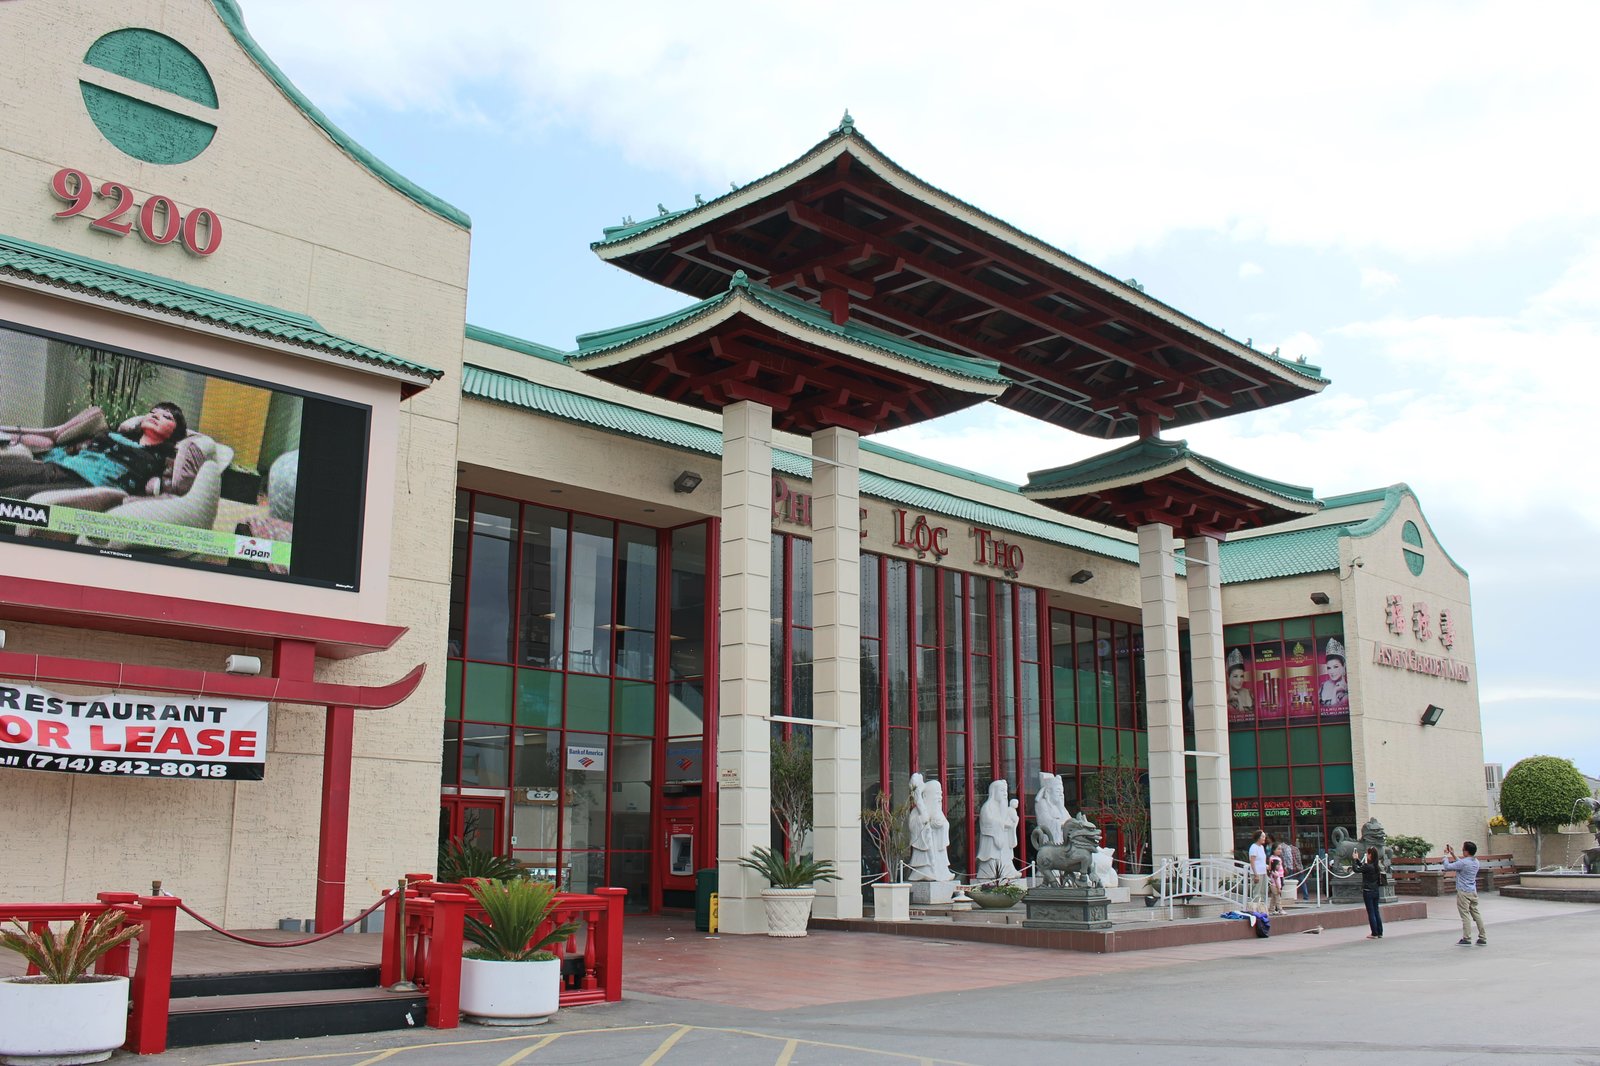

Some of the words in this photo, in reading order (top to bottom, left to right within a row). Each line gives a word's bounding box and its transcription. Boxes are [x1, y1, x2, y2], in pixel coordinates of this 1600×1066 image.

[51, 168, 222, 256] 9200
[1375, 643, 1407, 670] ASIAN
[1406, 649, 1447, 680] GARDEN
[1447, 657, 1471, 683] MALL
[0, 686, 227, 723] RESTAURANT
[90, 725, 257, 757] LEASE
[586, 749, 603, 757] America
[27, 753, 94, 772] (714)
[99, 760, 227, 778] 842-8018
[1265, 809, 1290, 817] CLOTHING
[1300, 808, 1317, 816] GIFTS
